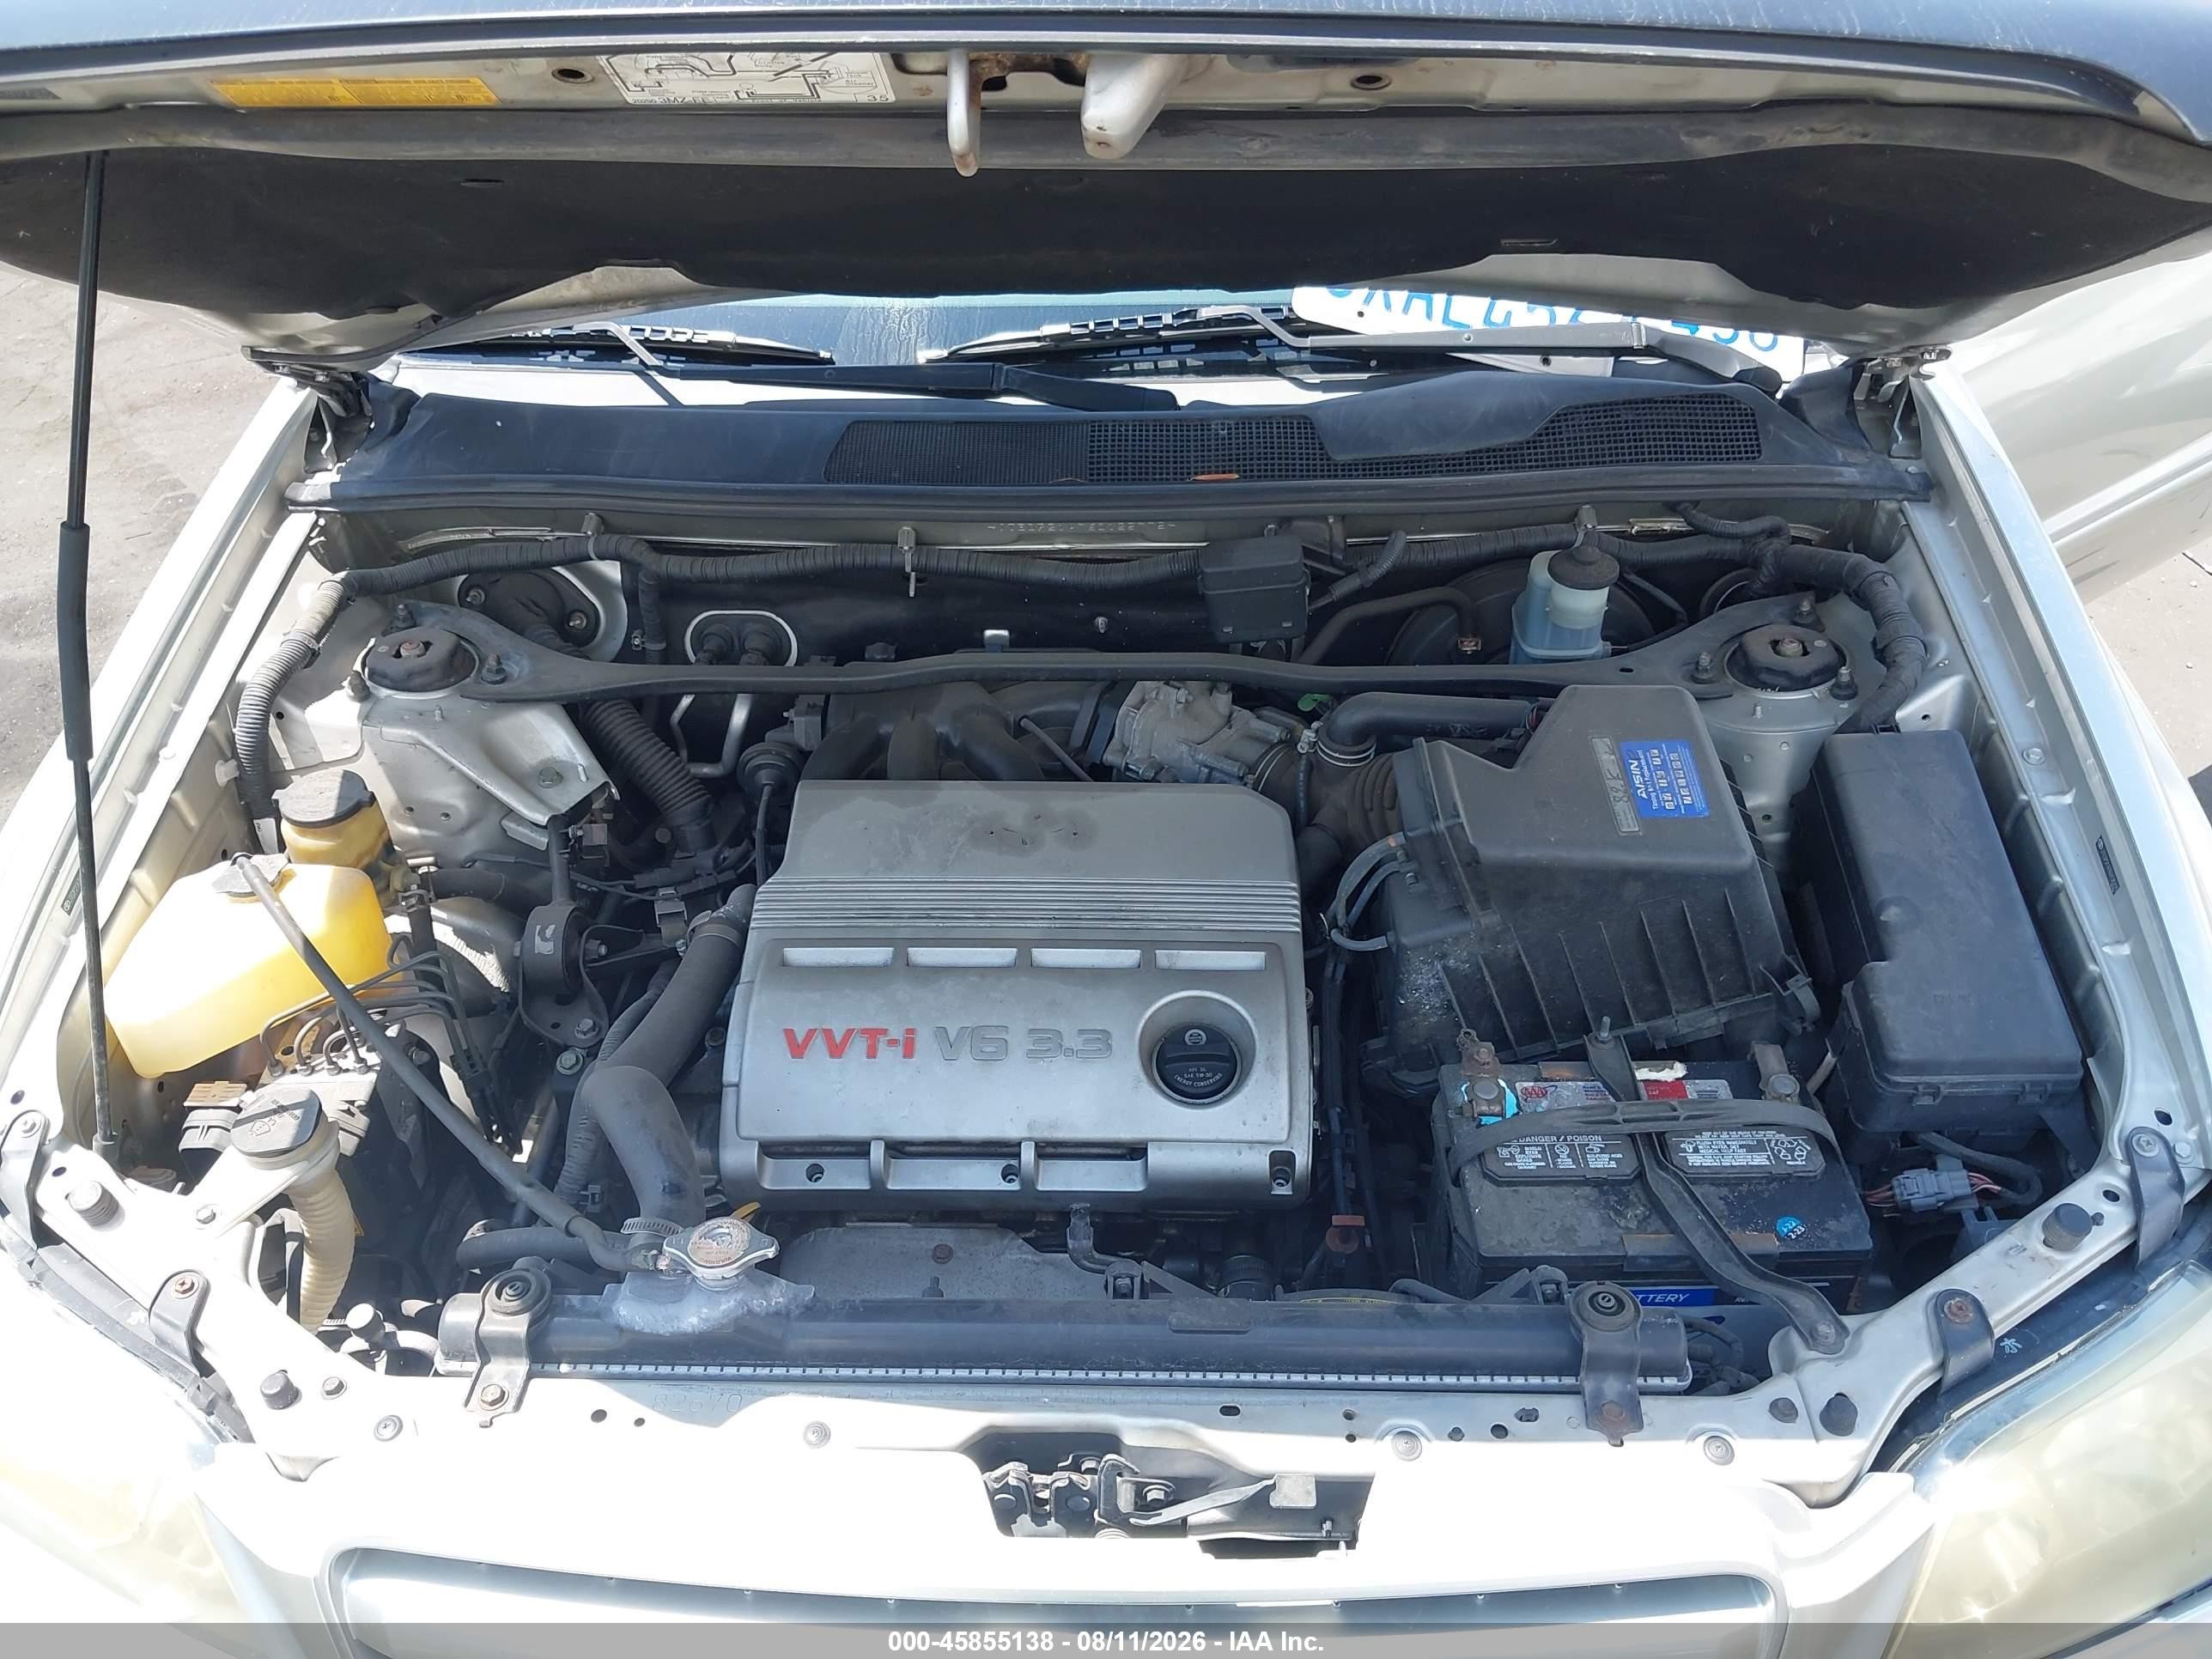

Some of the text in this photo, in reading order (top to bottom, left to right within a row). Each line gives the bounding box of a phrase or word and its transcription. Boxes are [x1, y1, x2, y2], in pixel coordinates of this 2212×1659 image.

[1628, 760, 1648, 799] AISIN
[783, 1025, 1113, 1060] VVT-i V6 3.3
[1174, 1073, 1224, 1087] ENERGY CONSERVING
[1636, 1294, 1690, 1303] TTERY
